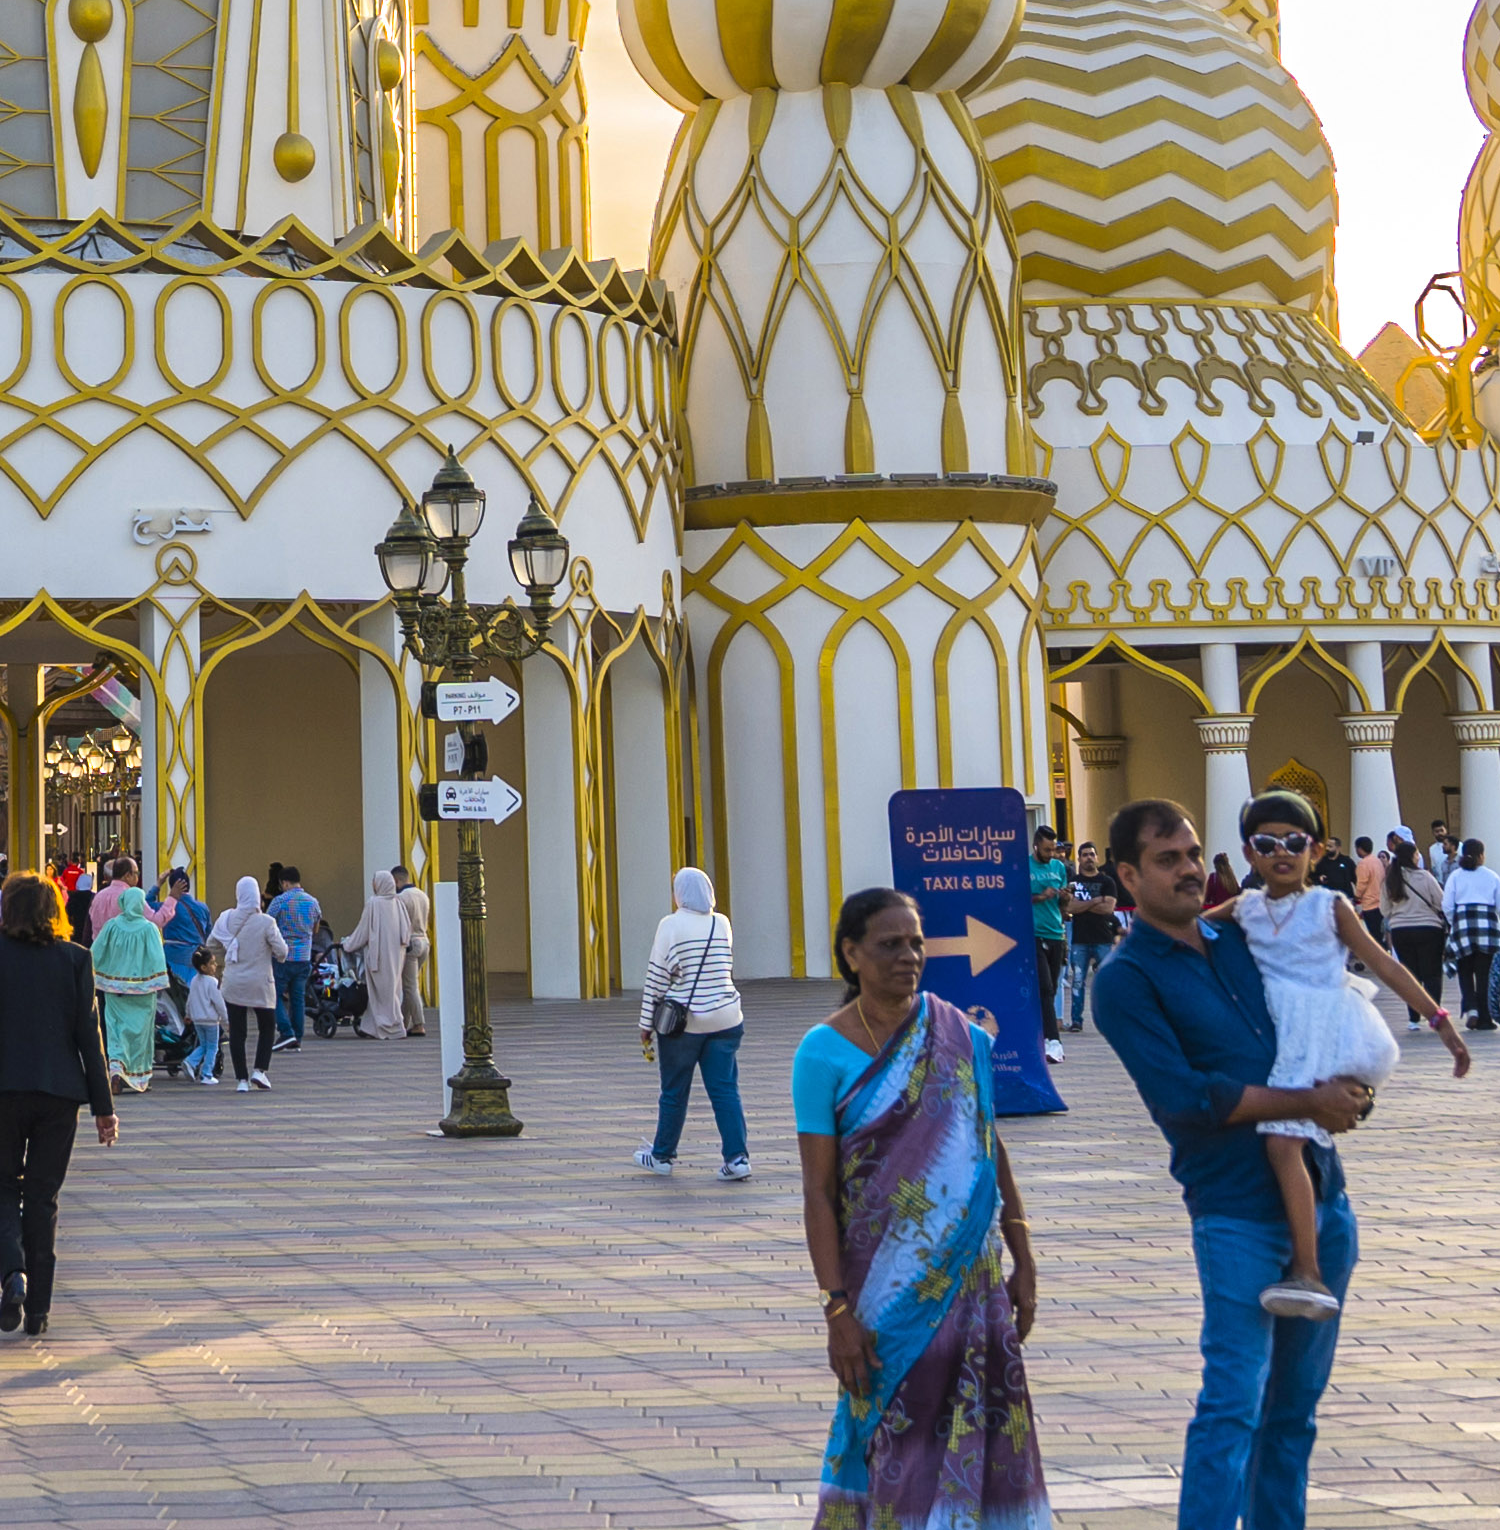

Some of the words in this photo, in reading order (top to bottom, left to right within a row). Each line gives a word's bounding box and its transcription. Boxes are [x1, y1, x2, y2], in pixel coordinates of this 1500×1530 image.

[132, 508, 213, 545] مخرج
[1360, 556, 1394, 576] VIP
[905, 824, 954, 847] الأجرة
[956, 826, 1016, 846] سيارات
[922, 844, 1002, 864] والحافلات
[923, 876, 958, 890] TAXI
[961, 876, 973, 889] &
[976, 875, 1005, 889] BUS
